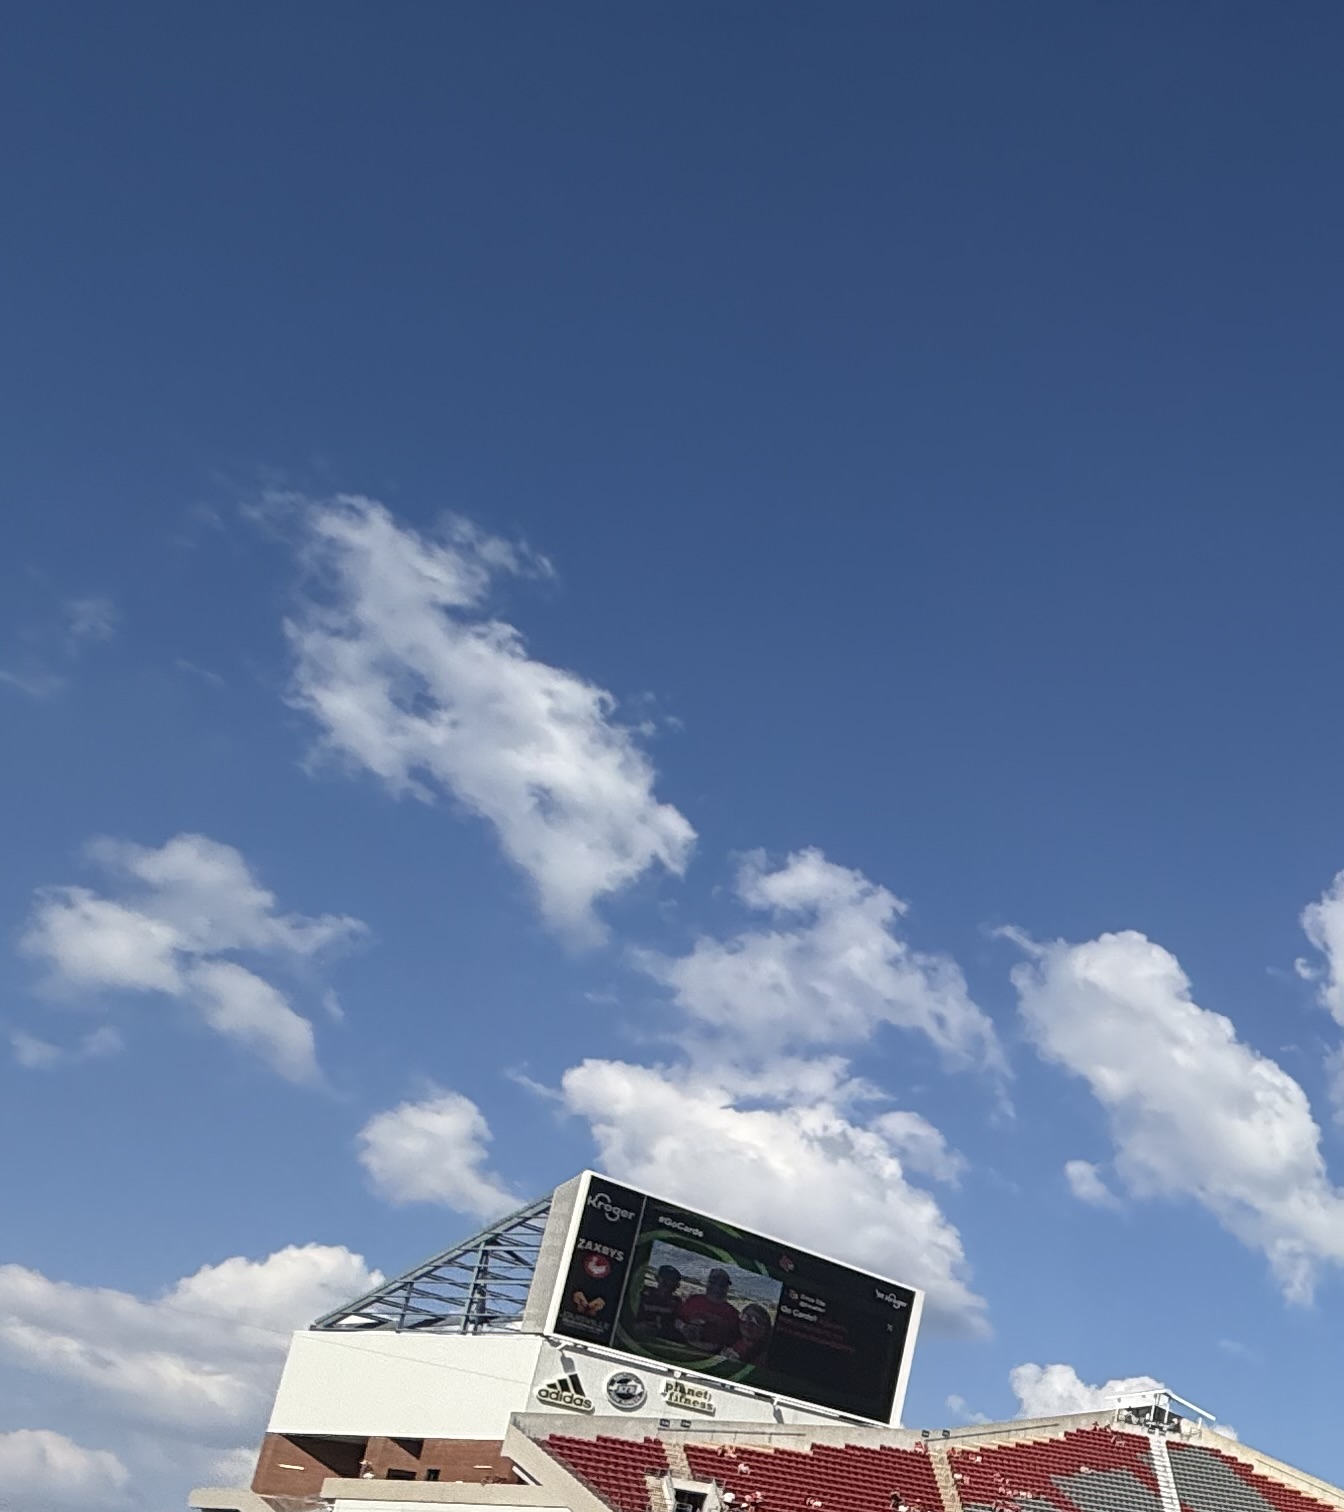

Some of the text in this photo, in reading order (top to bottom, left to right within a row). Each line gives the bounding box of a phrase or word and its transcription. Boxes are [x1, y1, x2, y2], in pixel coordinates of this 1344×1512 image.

[587, 1193, 636, 1221] Kroger
[538, 1388, 592, 1410] adidas
[667, 1391, 714, 1411] fitness
